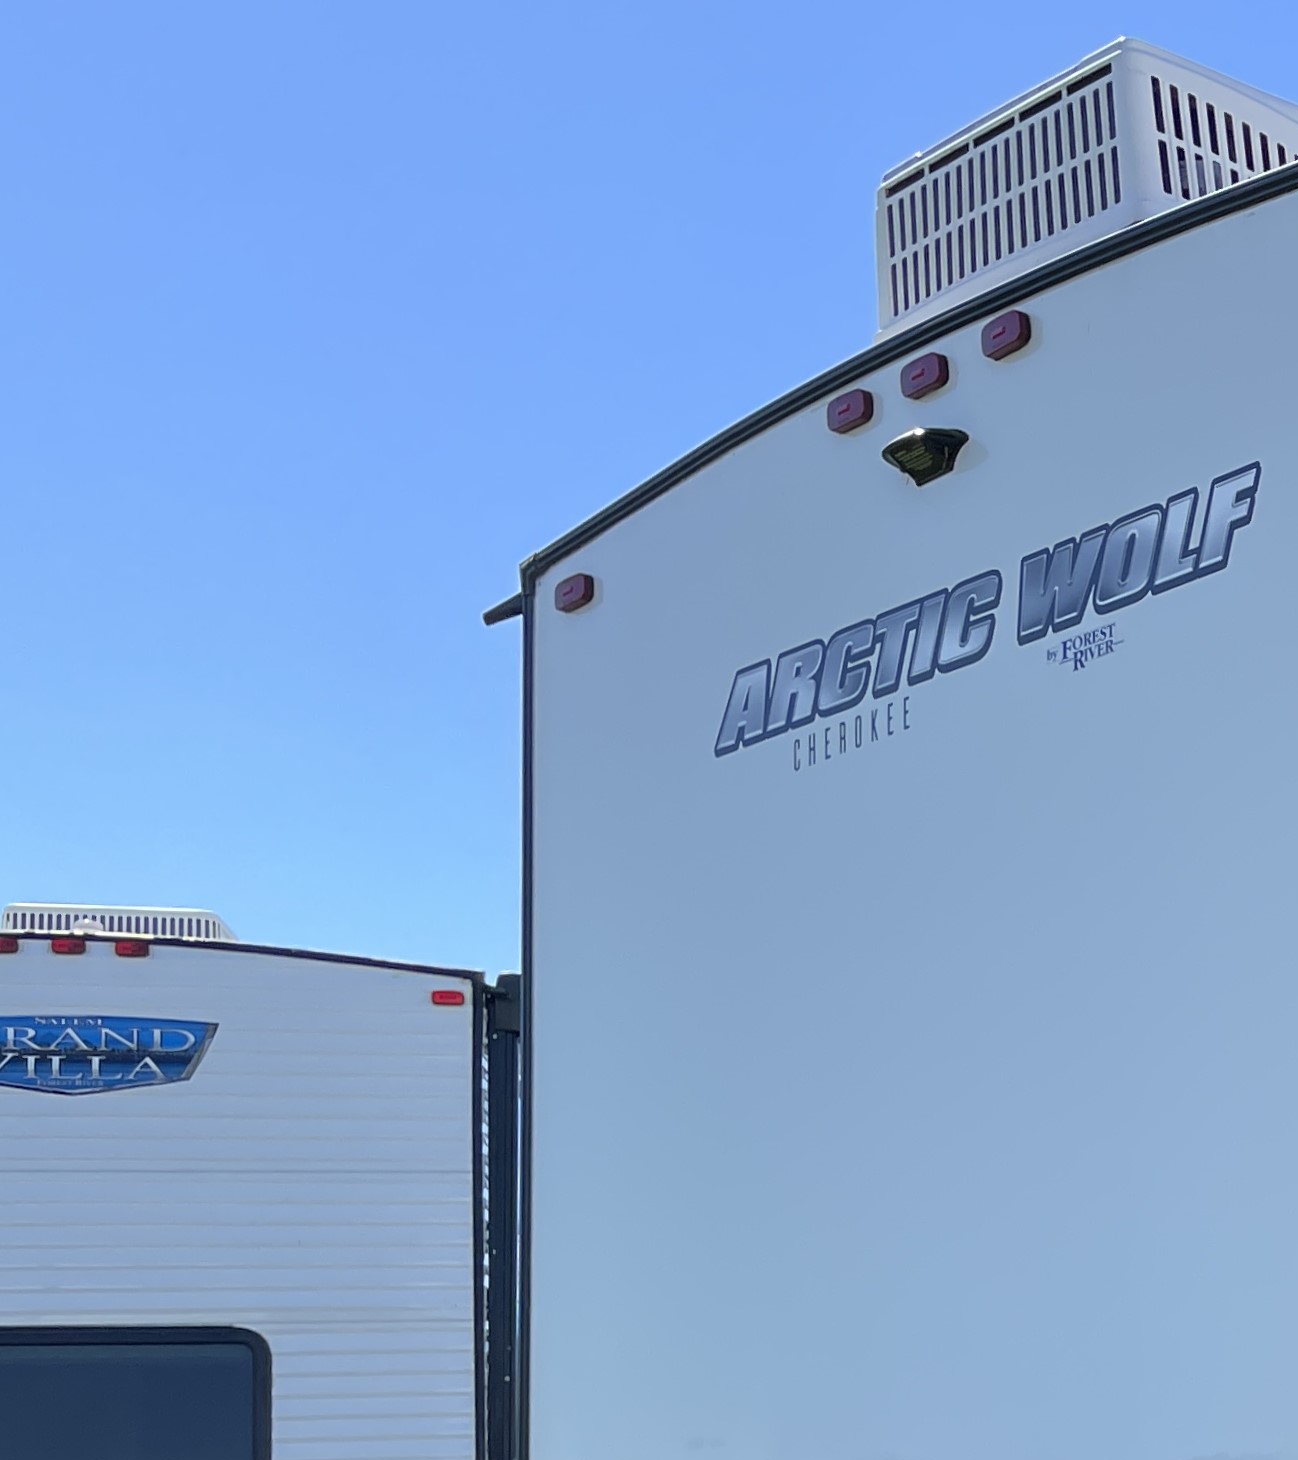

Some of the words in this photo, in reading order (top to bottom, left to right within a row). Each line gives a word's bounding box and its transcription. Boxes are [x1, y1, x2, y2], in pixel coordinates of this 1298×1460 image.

[713, 568, 1003, 758] ARCTIC
[1016, 461, 1261, 645] WOLF
[1046, 648, 1058, 663] by
[1061, 622, 1116, 661] FOREST
[1073, 639, 1115, 672] RIVER
[793, 696, 911, 772] CHEROKEE
[4, 1026, 196, 1052] RAND
